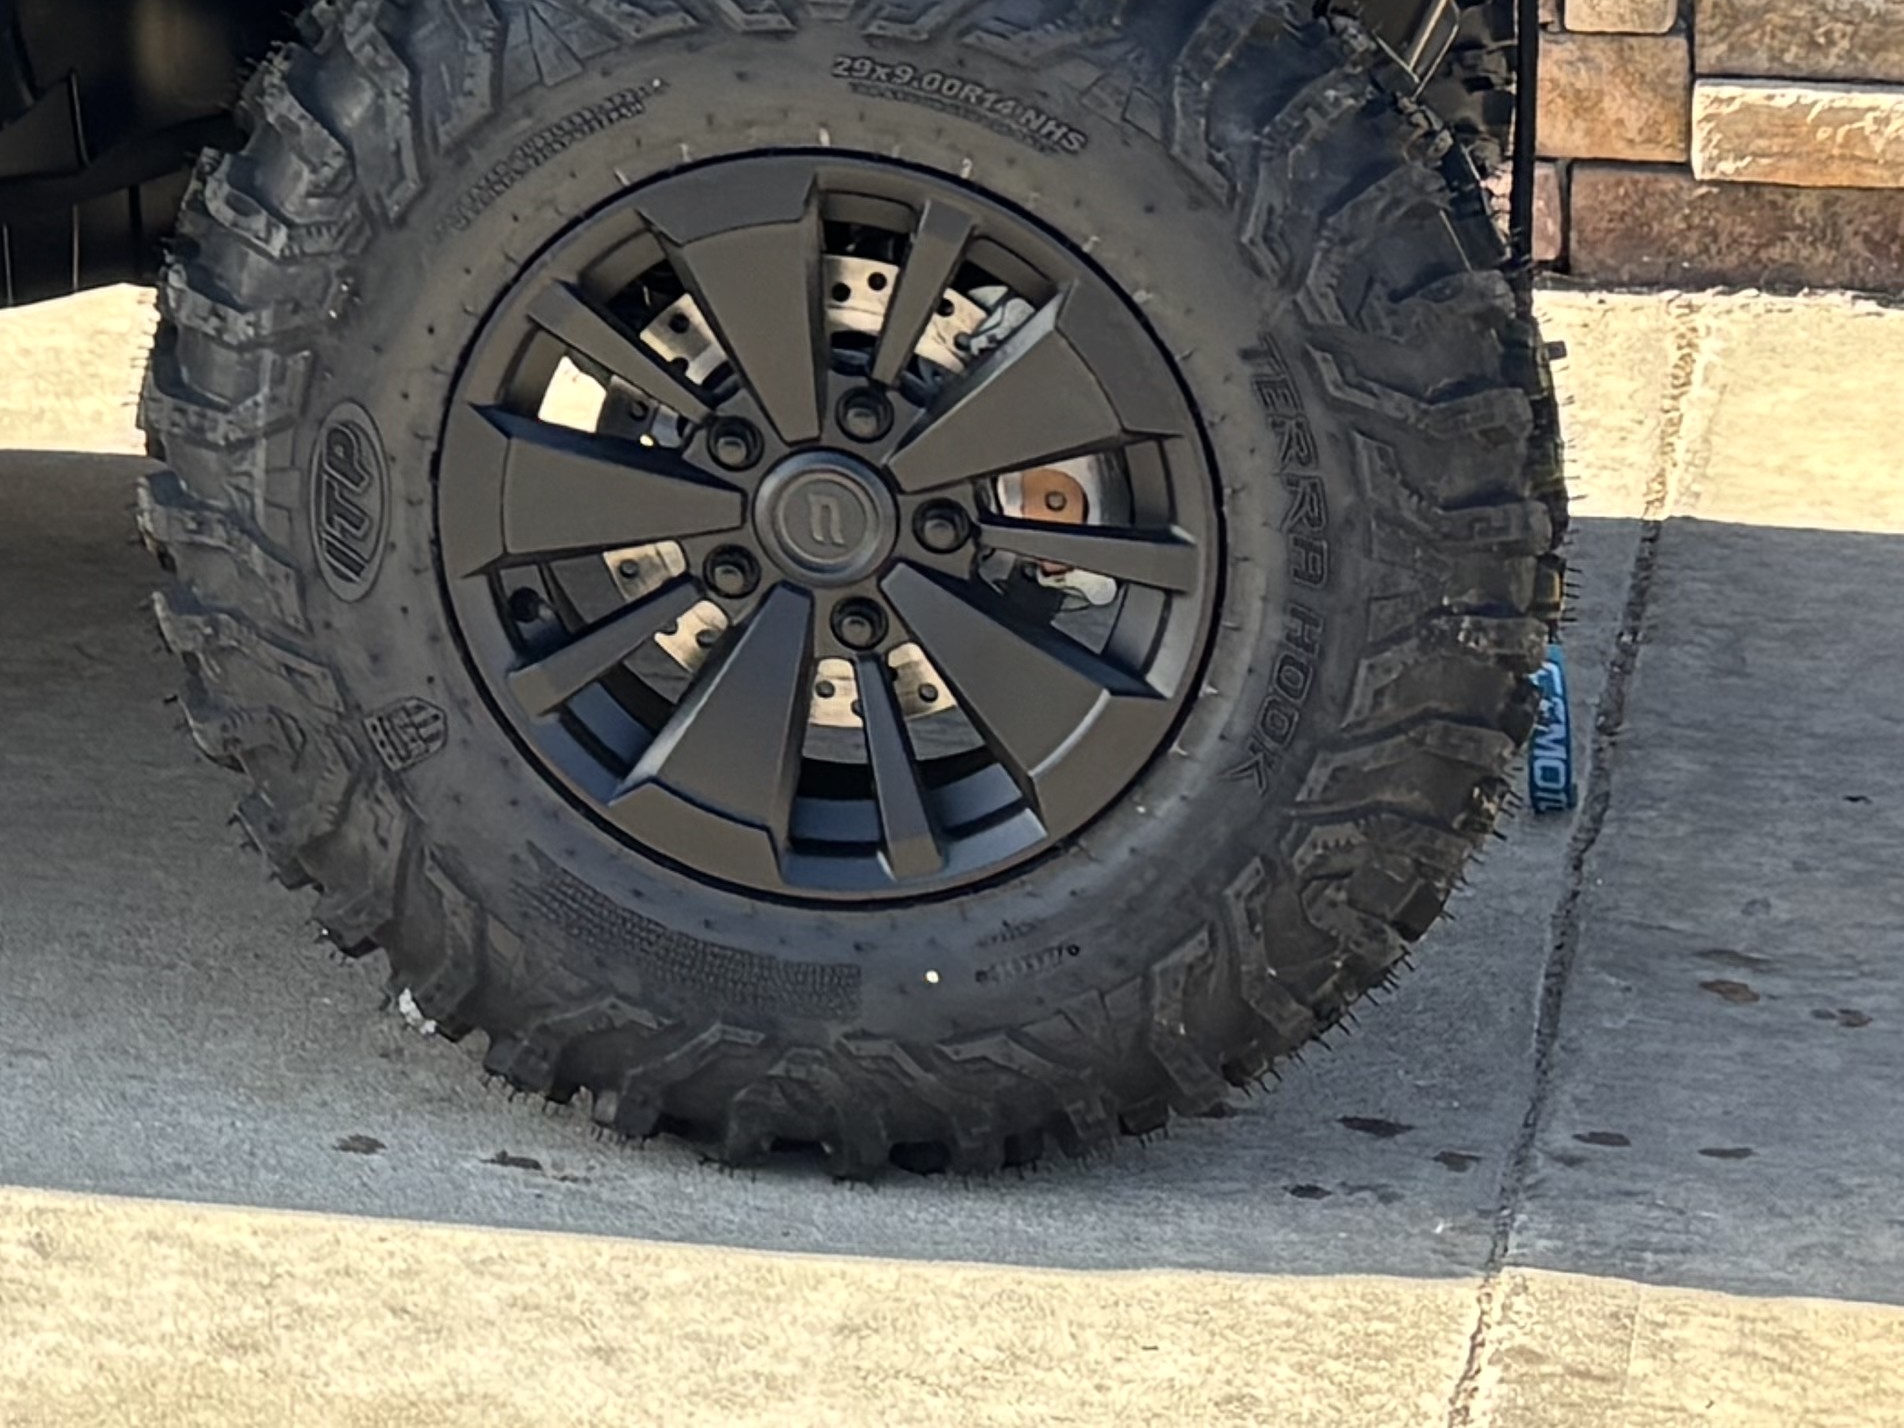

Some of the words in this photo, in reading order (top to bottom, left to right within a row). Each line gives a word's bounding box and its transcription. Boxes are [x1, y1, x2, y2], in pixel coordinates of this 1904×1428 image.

[833, 55, 1016, 117] 29x9.00R14
[1020, 105, 1088, 154] NHS
[322, 420, 372, 582] ITP
[1238, 332, 1328, 588] TERRA
[1216, 602, 1324, 796] HOOK
